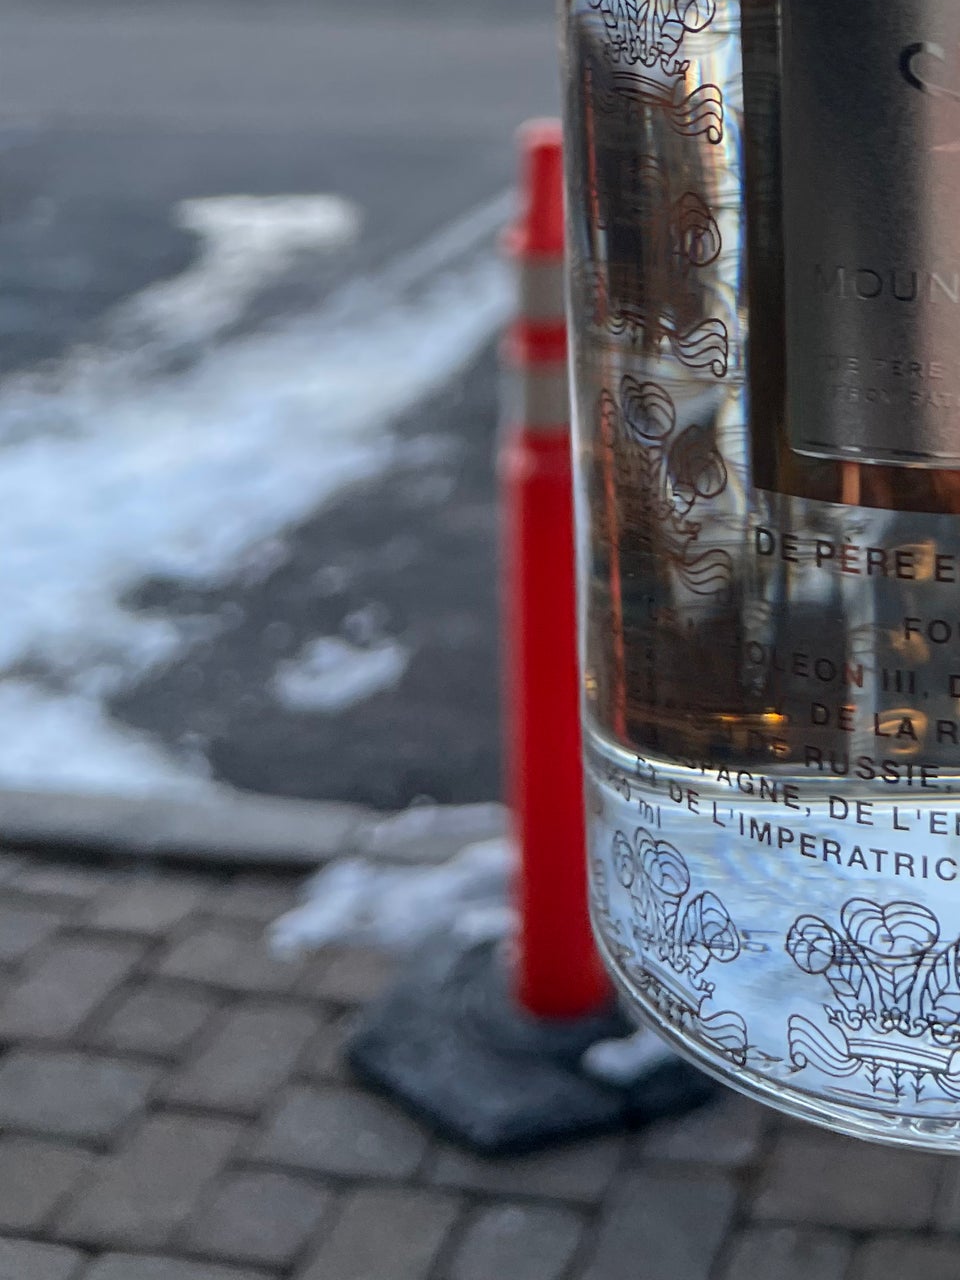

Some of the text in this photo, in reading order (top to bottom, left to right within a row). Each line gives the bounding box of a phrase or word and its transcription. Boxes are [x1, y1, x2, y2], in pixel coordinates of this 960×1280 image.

[755, 526, 799, 563] DE
[812, 703, 856, 732] DE
[875, 712, 919, 742] LA
[804, 745, 952, 793] RUSSIE,
[668, 779, 700, 815] DE
[828, 795, 875, 827] DE
